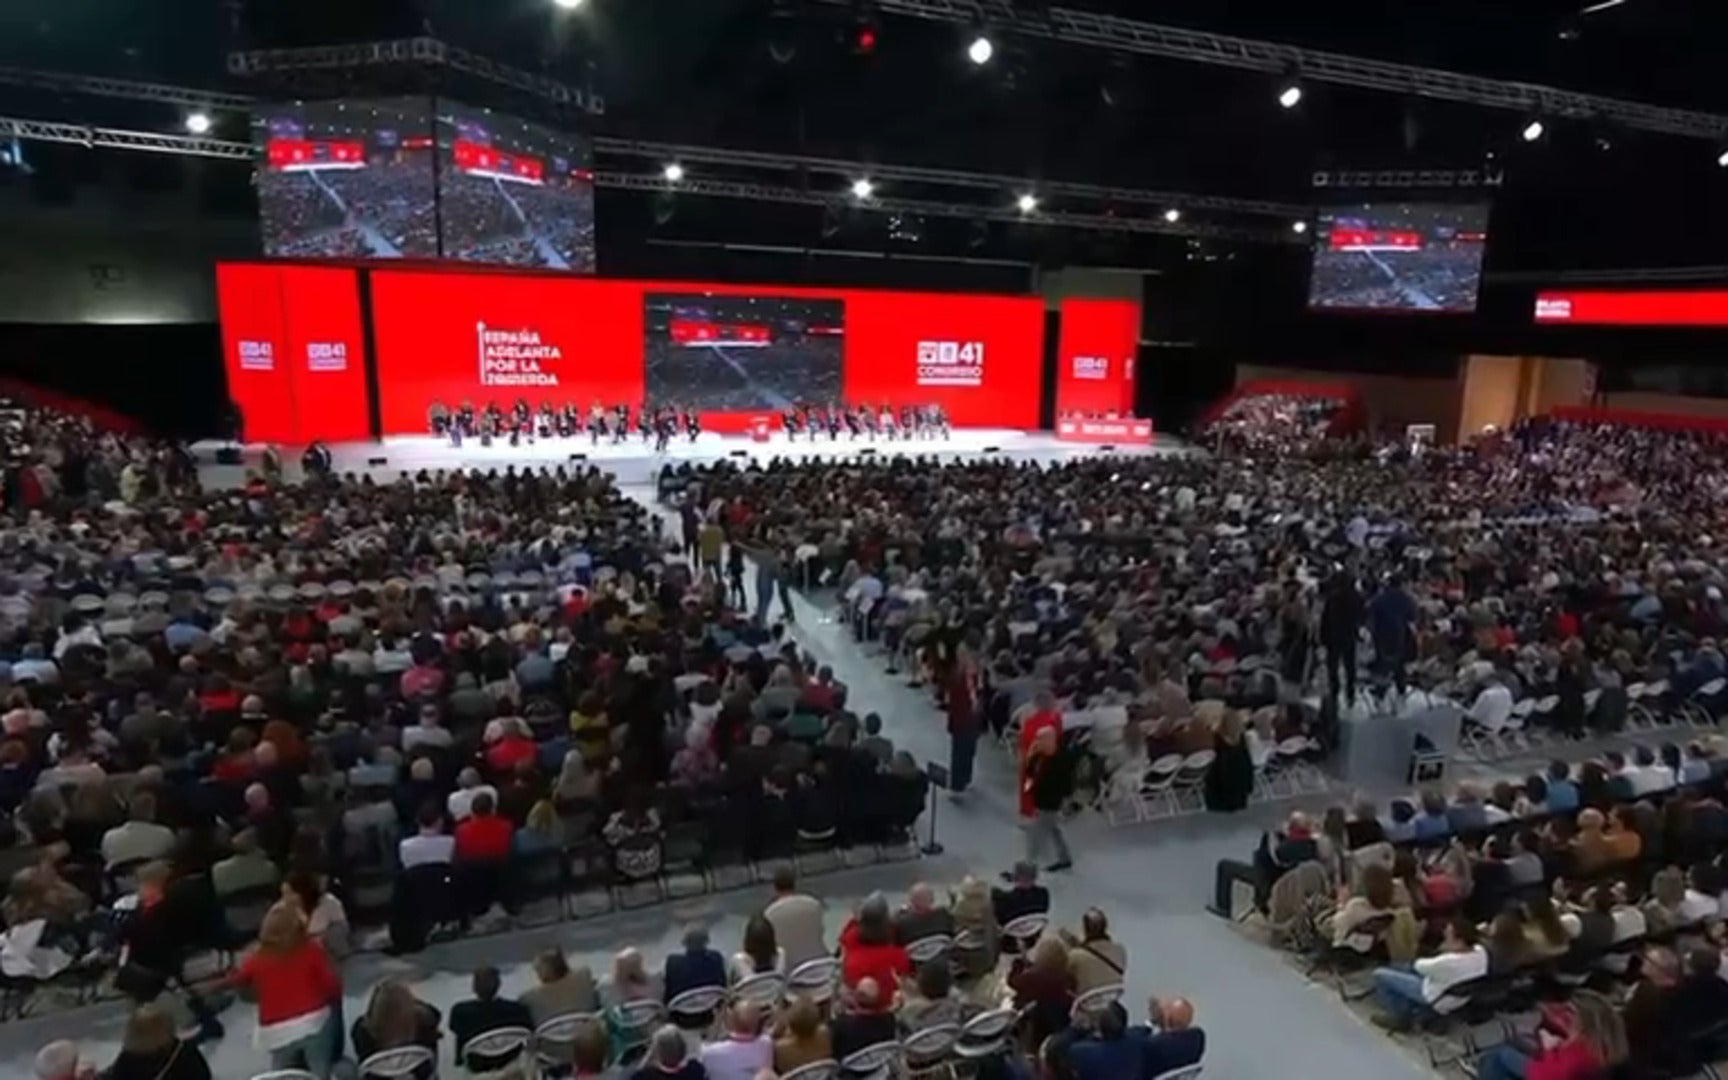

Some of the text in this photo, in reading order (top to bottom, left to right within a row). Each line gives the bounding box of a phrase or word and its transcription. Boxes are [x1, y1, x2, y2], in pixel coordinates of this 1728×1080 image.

[485, 345, 562, 359] ADELANTA
[958, 341, 984, 364] 41
[485, 359, 541, 373] POR LA
